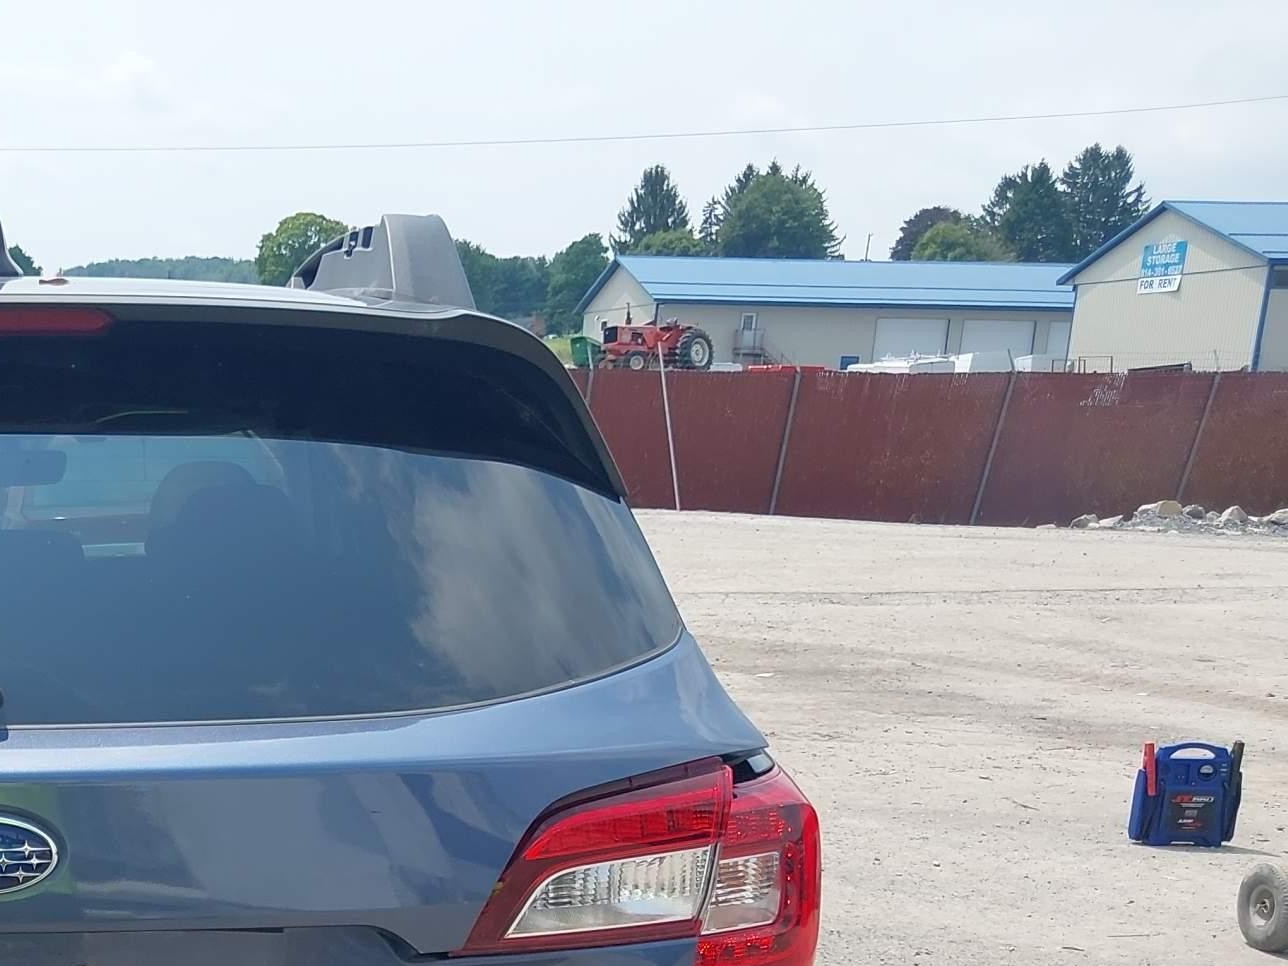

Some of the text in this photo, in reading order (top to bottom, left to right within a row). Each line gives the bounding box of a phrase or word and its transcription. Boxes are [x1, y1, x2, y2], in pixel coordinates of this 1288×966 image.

[1153, 243, 1177, 254] LARGE
[1146, 253, 1180, 266] STORAGE
[1139, 278, 1177, 290] FOR RENT
